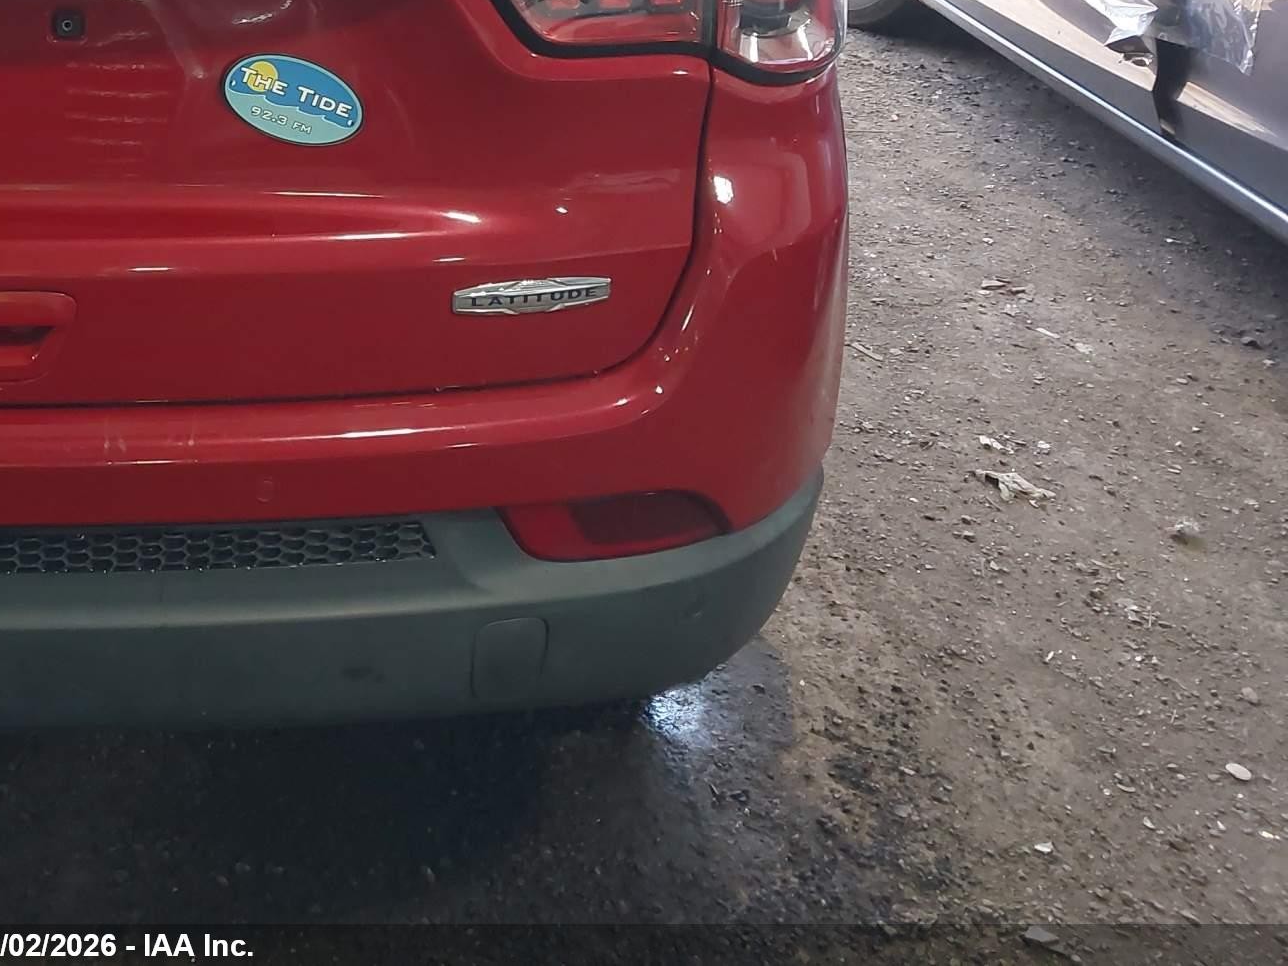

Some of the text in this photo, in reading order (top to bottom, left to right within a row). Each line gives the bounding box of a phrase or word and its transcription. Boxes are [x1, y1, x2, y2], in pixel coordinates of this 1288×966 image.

[240, 67, 353, 118] THE TIDE
[251, 106, 312, 135] 92.3 FM
[470, 287, 596, 308] LATITUDE
